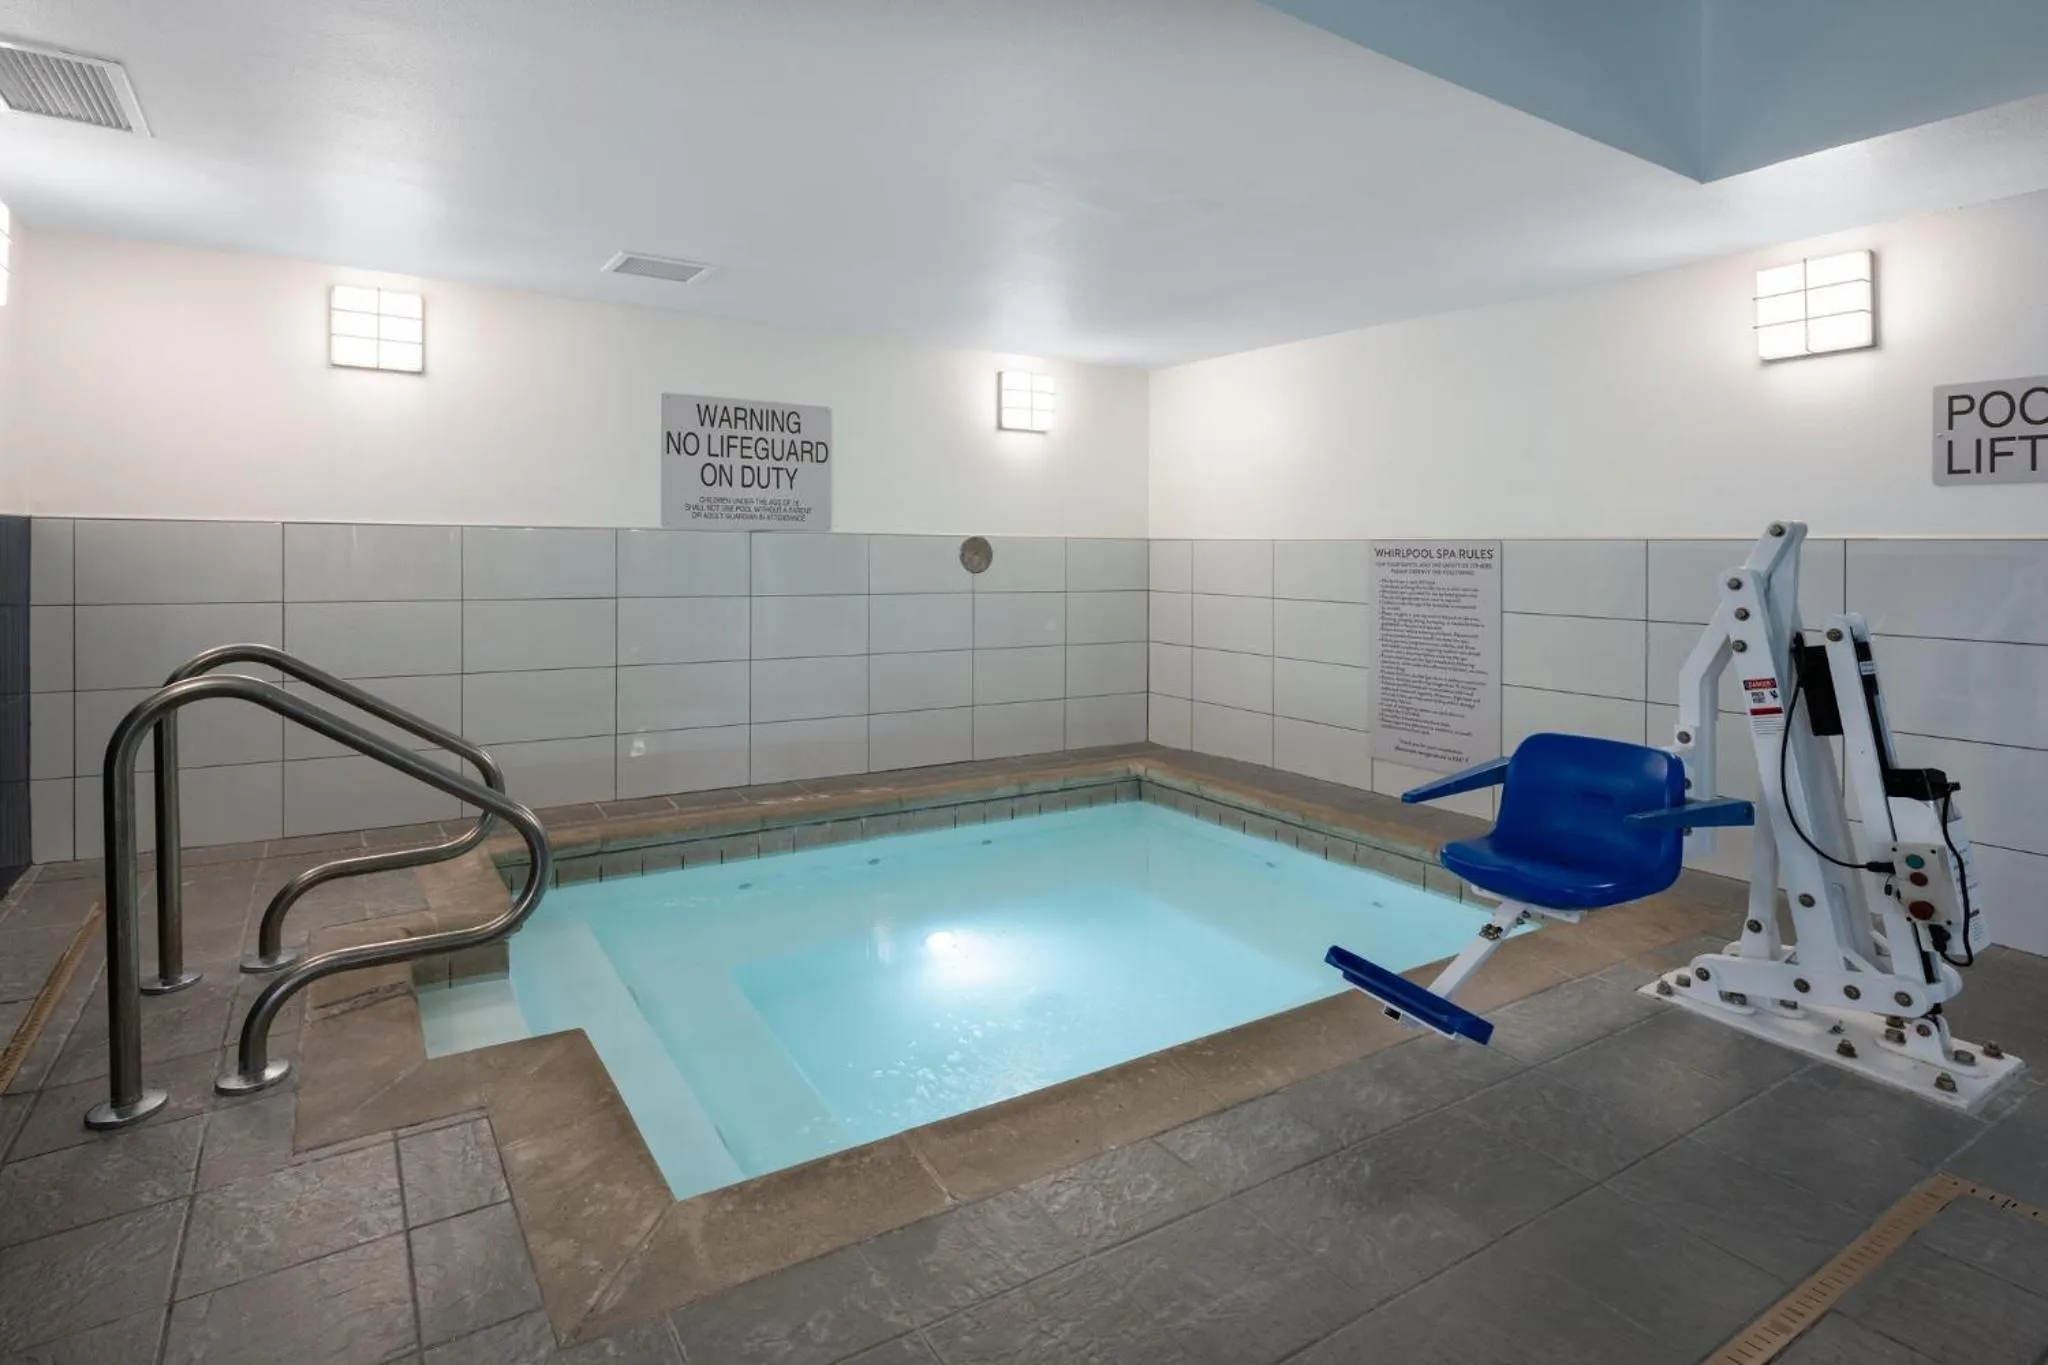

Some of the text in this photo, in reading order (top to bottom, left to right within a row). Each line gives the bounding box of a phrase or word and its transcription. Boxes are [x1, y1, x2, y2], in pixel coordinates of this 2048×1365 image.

[696, 403, 802, 434] WARNING
[666, 431, 829, 464] NO LIFEGUARD
[1946, 434, 2048, 475] LIFT
[701, 462, 799, 490] ON DUTY
[1374, 547, 1494, 560] WHIRLPOOL SPA RULES
